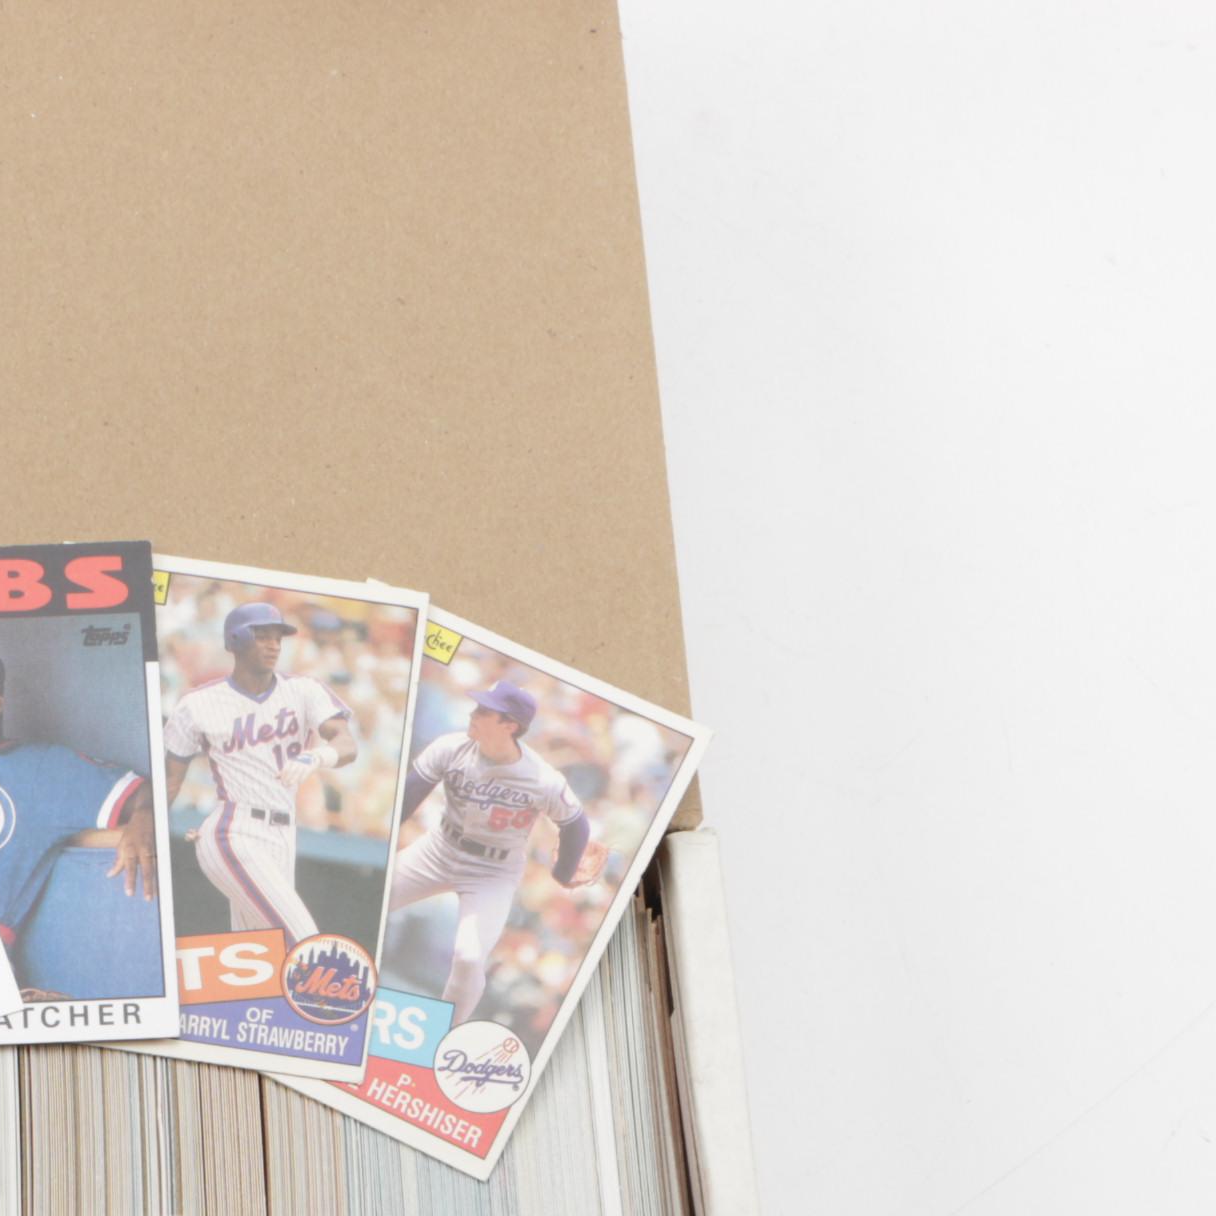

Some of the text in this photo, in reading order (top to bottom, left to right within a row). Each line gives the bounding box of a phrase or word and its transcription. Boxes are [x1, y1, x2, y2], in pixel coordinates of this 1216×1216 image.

[425, 628, 454, 653] Chee
[222, 706, 300, 754] Mets
[177, 942, 274, 991] TS
[295, 965, 362, 1002] Mets
[178, 1013, 350, 1058] ARRYL STRAWBERRY
[245, 1006, 275, 1024] OF
[372, 1000, 428, 1051] RS
[437, 1048, 525, 1088] Dodgers
[366, 1077, 483, 1149] HERSHISER
